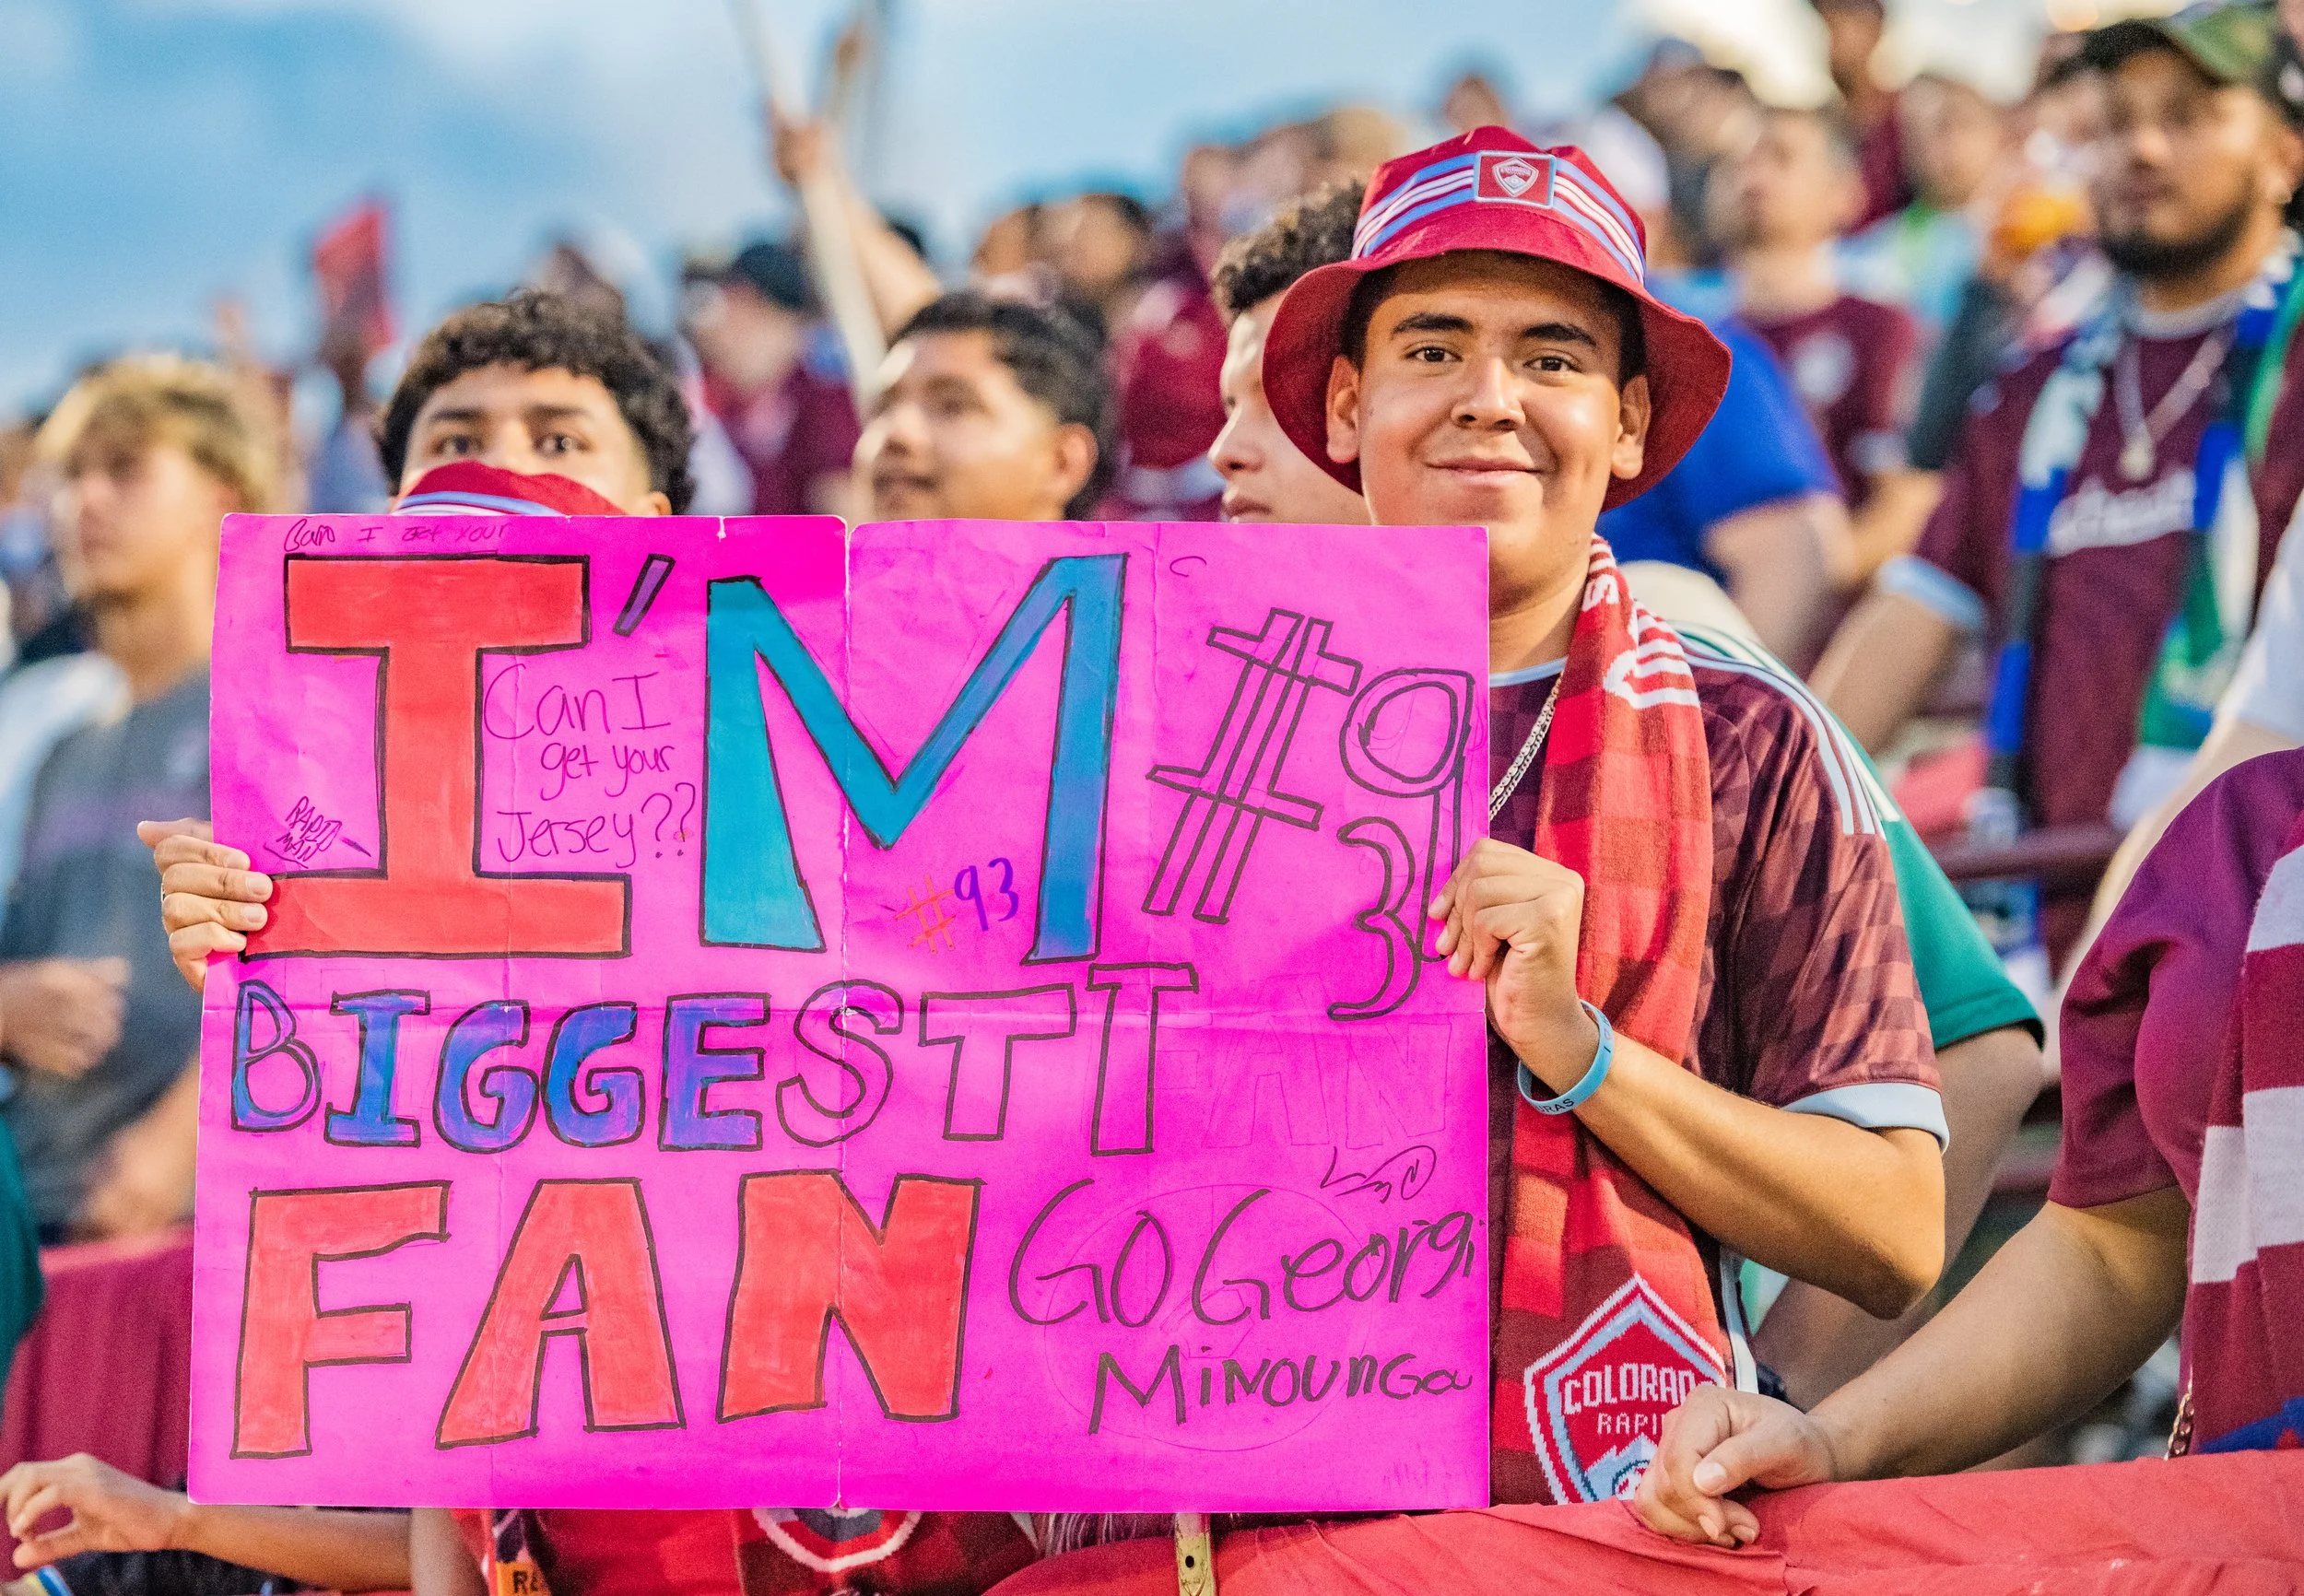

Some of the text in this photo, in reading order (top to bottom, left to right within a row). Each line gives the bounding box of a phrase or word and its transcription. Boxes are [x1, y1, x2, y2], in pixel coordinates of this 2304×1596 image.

[484, 663, 672, 740] Can I
[239, 551, 1129, 964] I'M
[540, 742, 676, 802] get your
[894, 857, 1019, 956] #93
[1191, 1188, 1487, 1326] Georgi
[229, 1168, 987, 1459] FAN
[1564, 1363, 1717, 1415] COLORAD
